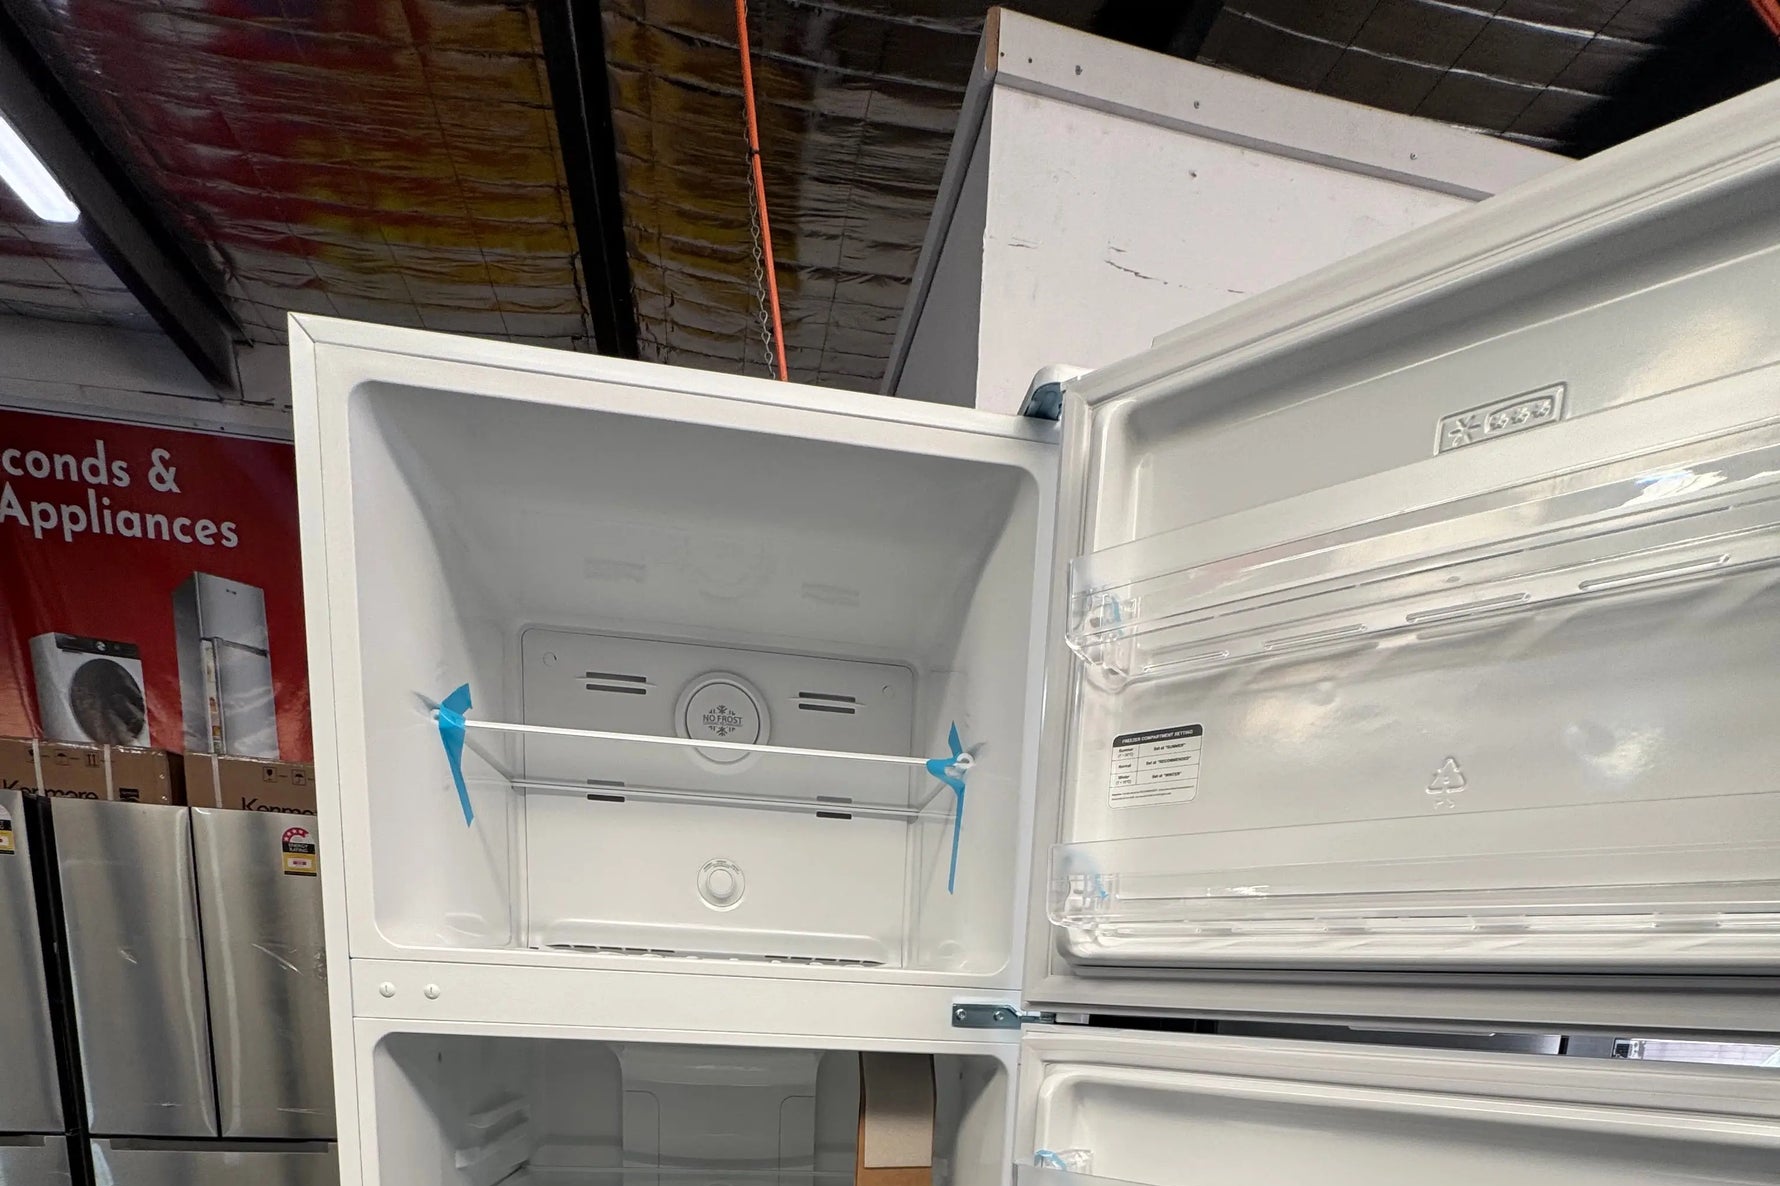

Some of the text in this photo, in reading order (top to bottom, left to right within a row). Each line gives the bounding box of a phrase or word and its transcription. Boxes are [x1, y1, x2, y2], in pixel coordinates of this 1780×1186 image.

[1, 438, 182, 494] conds &
[0, 480, 239, 548] Appliances
[703, 713, 716, 722] NO
[717, 714, 743, 725] FROST
